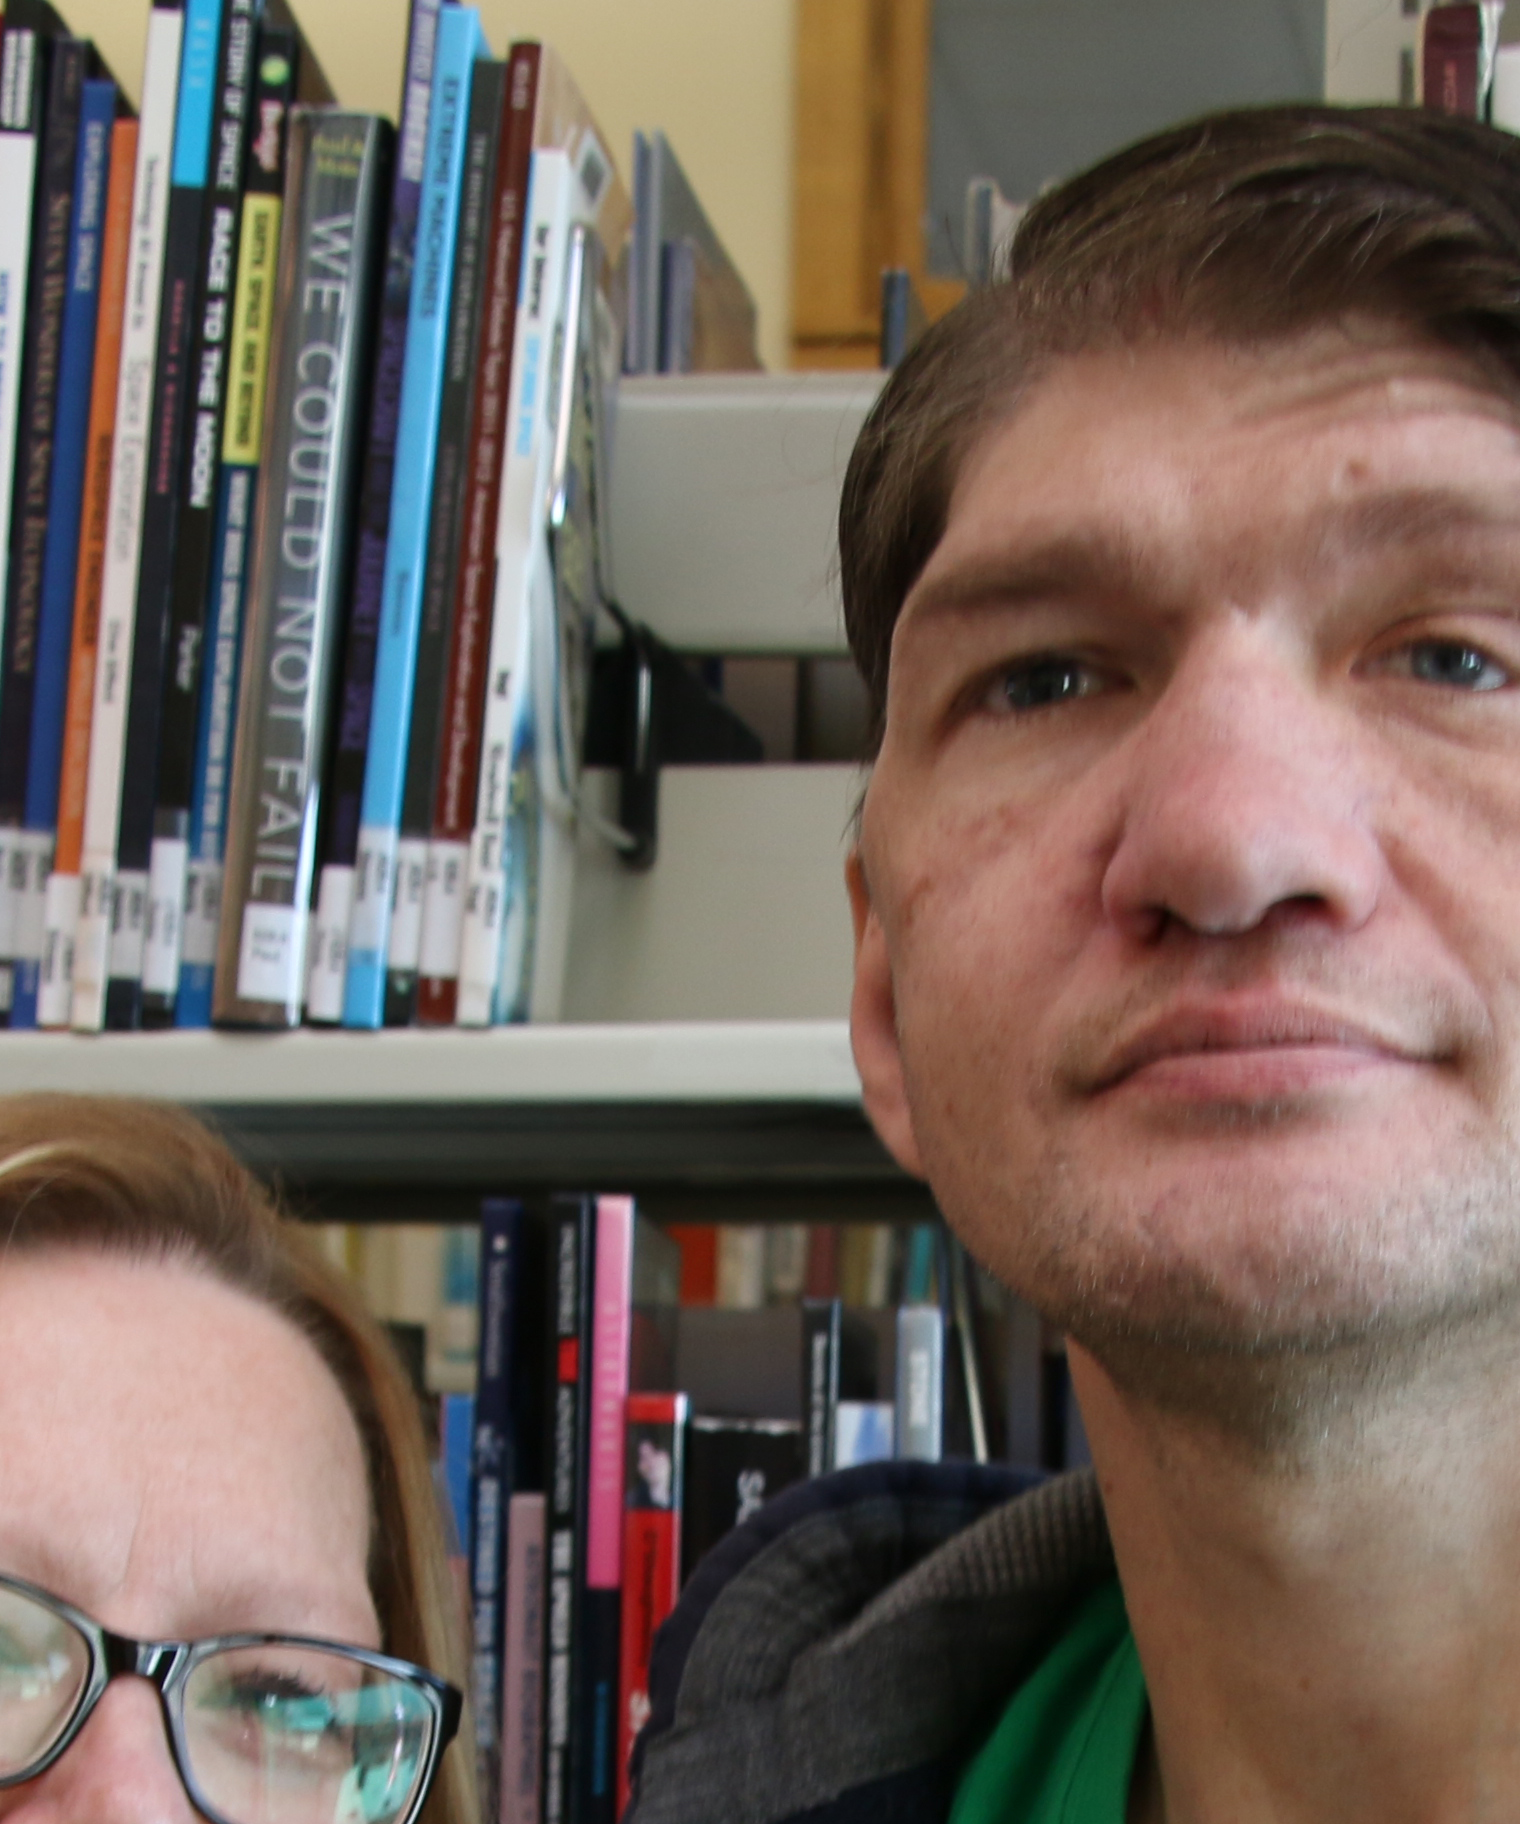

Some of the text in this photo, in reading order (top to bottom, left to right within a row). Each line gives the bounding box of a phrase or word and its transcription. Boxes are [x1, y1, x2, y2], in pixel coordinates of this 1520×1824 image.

[214, 18, 252, 191] STORY SPACE
[433, 77, 461, 186] EXTREME
[73, 119, 105, 292] EXPLORING SPACE
[419, 192, 452, 321] MACHINES
[189, 207, 234, 509] RACE TO THE MOON
[250, 212, 355, 898] WE COULD NOT FAIL
[176, 625, 201, 692] Parker
